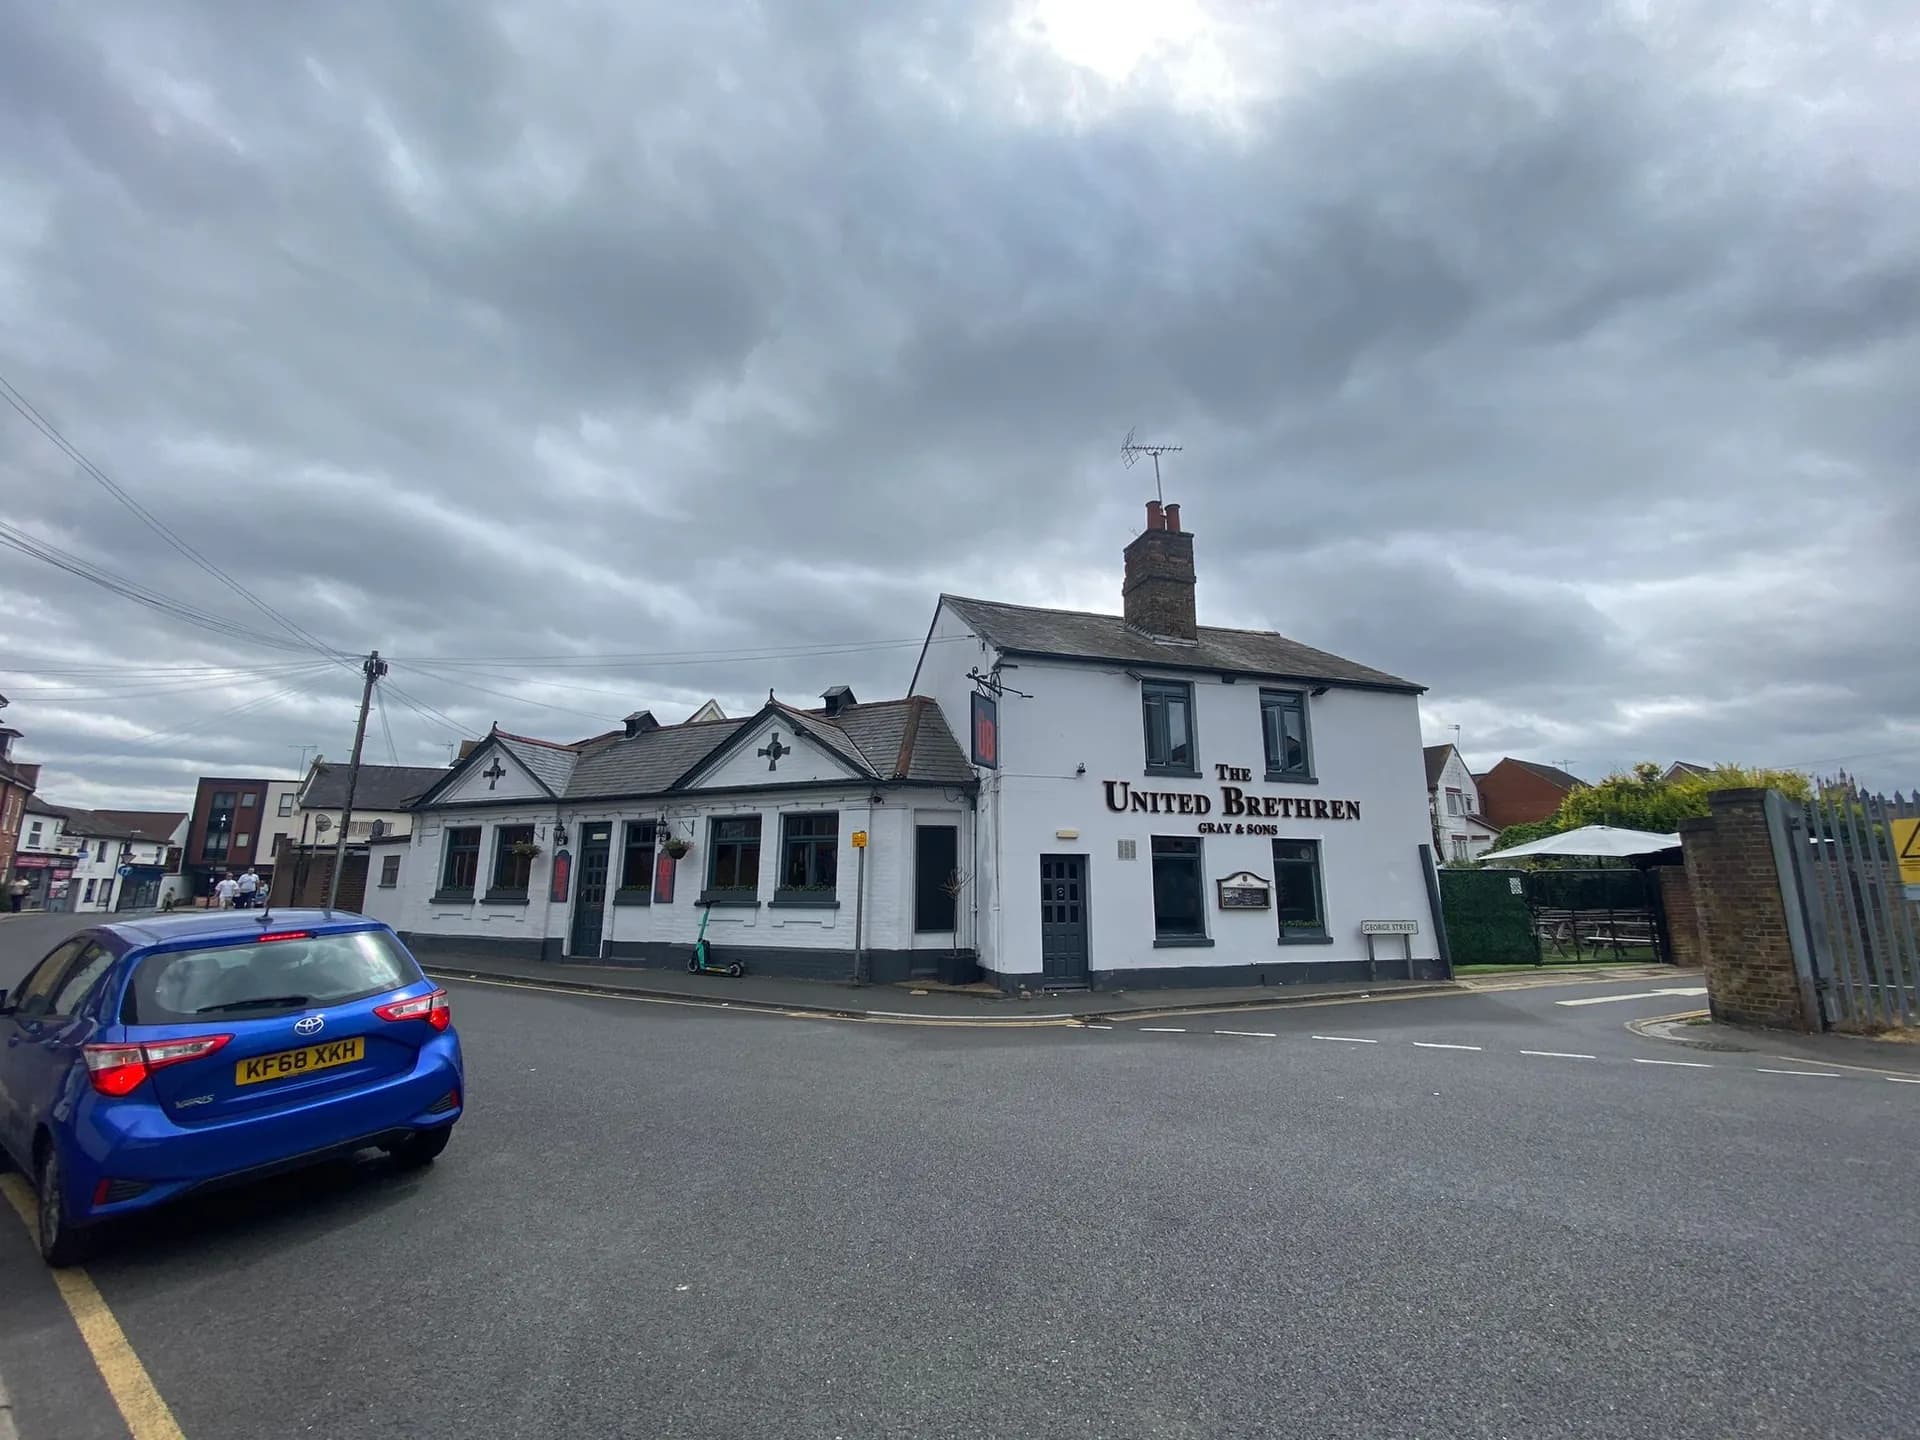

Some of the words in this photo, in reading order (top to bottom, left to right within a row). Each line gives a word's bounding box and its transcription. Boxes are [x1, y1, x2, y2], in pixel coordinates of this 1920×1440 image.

[1215, 764, 1252, 782] THE
[1102, 780, 1211, 815] UNITED
[1221, 786, 1361, 821] BRETHREN
[1198, 823, 1232, 834] GRAY
[1236, 825, 1244, 835] &
[1247, 824, 1278, 835] SONS
[1365, 923, 1390, 931] GEORGE
[1391, 923, 1415, 931] STREET
[246, 1053, 307, 1080] KF68
[314, 1041, 356, 1065] XKH
